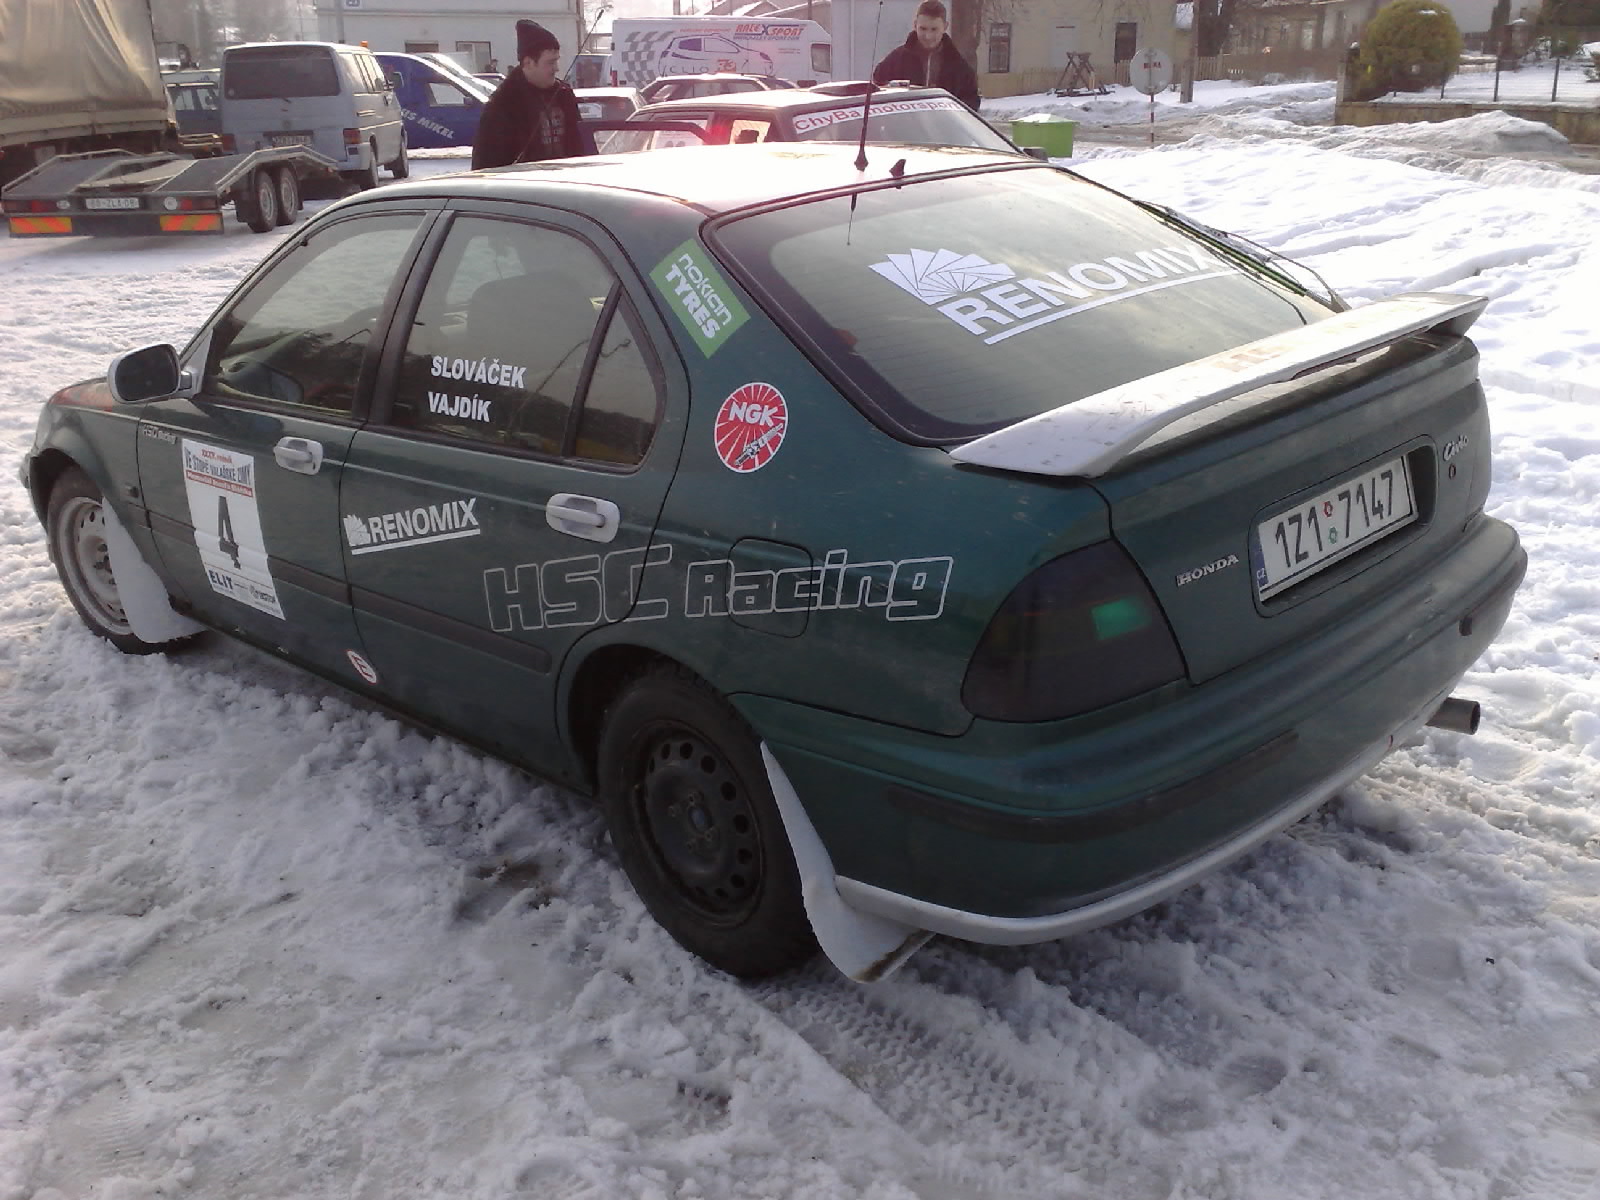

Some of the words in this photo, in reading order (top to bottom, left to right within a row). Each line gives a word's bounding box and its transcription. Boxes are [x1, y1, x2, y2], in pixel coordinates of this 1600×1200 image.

[795, 110, 861, 130] ChyBa
[868, 100, 963, 117] motorsport
[665, 263, 720, 338] TYRES
[936, 245, 1214, 336] RENOMIX
[430, 355, 527, 389] SLOVÁČEK
[427, 391, 491, 423] VAJDÍK
[728, 401, 779, 427] NGK
[218, 495, 241, 570] 4
[368, 498, 479, 543] RENOMIX
[1275, 506, 1323, 568] 1Z1
[1338, 469, 1393, 538] 7147
[208, 569, 234, 591] ELIT
[1176, 554, 1240, 587] HONDA
[1256, 567, 1267, 579] CZ
[484, 544, 673, 632] HSC
[684, 548, 954, 622] Racing
